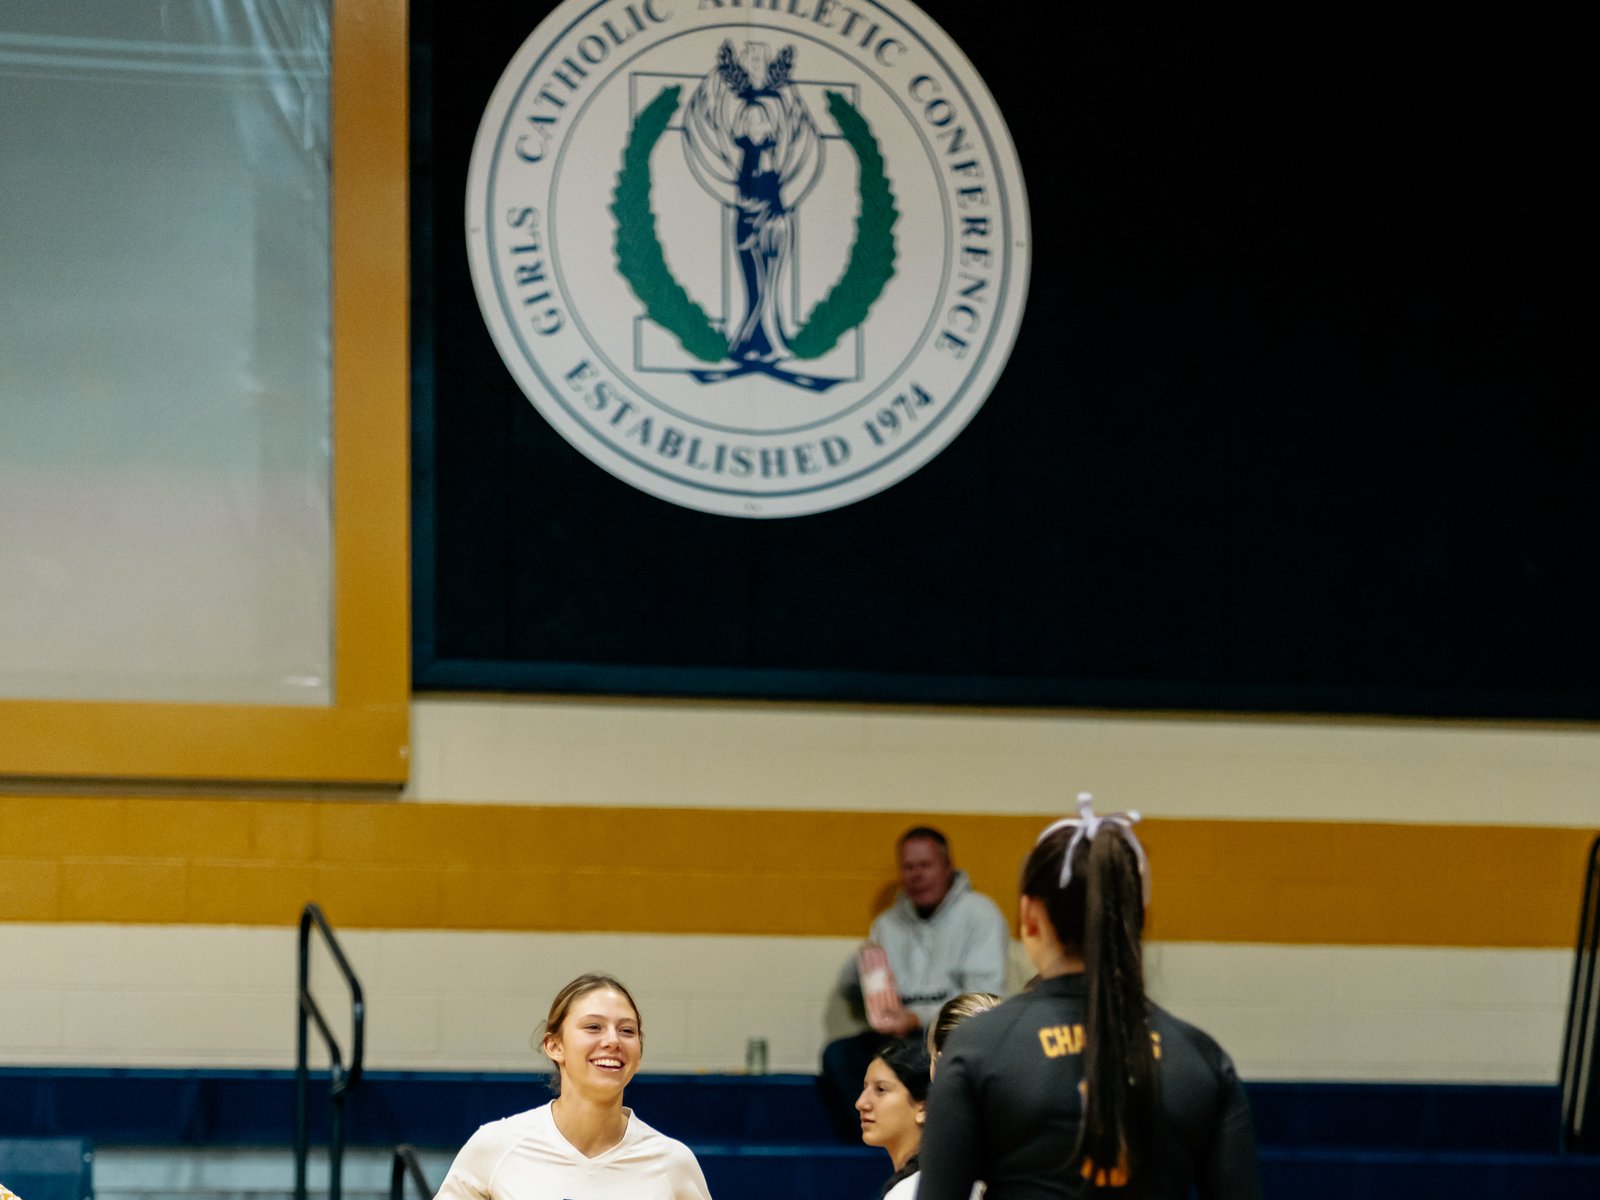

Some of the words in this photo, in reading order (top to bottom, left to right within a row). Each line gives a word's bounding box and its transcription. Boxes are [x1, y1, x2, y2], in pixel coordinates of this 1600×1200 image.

[514, 0, 674, 164] CATHOLIC
[506, 205, 566, 336] GIRLS
[907, 74, 992, 360] CONFERENCE
[565, 359, 851, 478] ESTABLISHED
[862, 381, 934, 447] 1974
